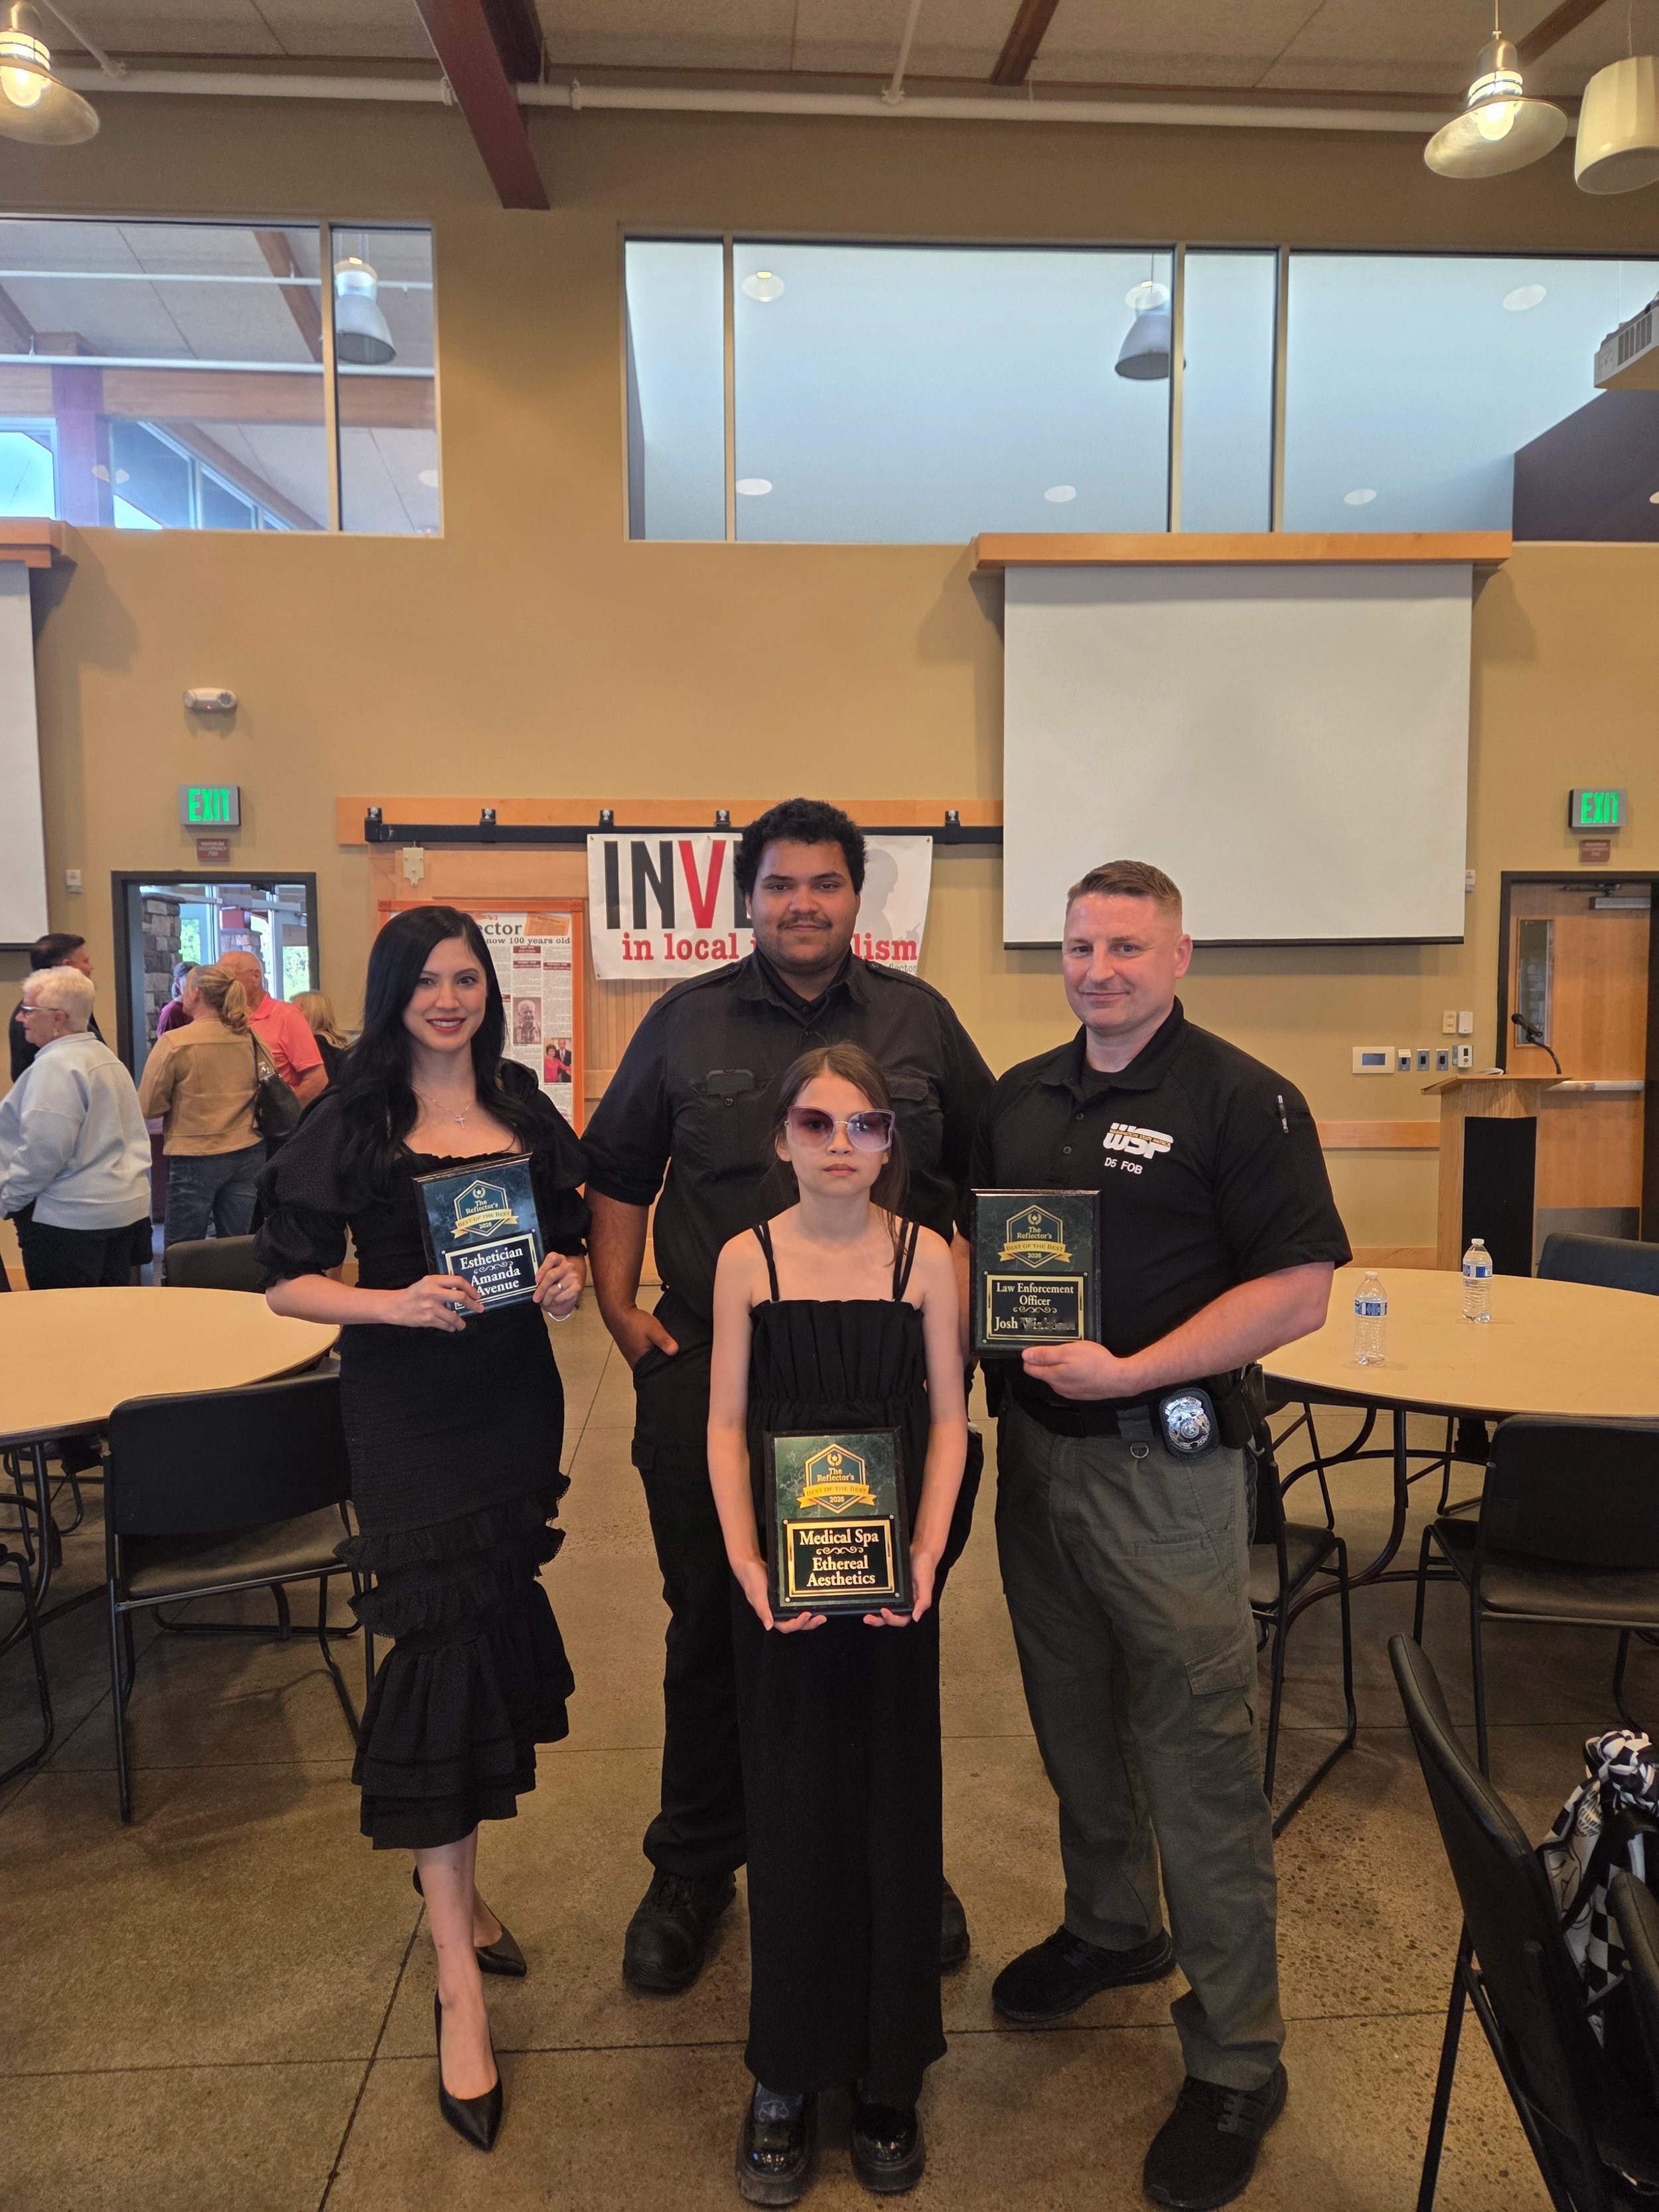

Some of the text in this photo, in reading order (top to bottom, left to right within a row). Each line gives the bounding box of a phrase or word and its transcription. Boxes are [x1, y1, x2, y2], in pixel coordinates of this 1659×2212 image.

[188, 788, 230, 821] EXIT
[1581, 792, 1620, 823] EXIT
[622, 932, 653, 960] in
[664, 932, 739, 960] local
[1120, 1160, 1143, 1175] FOB
[465, 1202, 498, 1215] Reflector's
[459, 1247, 523, 1270] Esthetician
[470, 1264, 522, 1287] Amanda
[477, 1280, 520, 1296] Avenue
[996, 1282, 1074, 1293] Law Enforcement
[1019, 1295, 1051, 1306] Officer
[994, 1316, 1018, 1331] Josh
[817, 1473, 855, 1482] Reflector's
[800, 1528, 879, 1547] Medical Spa
[812, 1555, 869, 1572] Ethereal
[806, 1571, 876, 1587] Aesthetics
